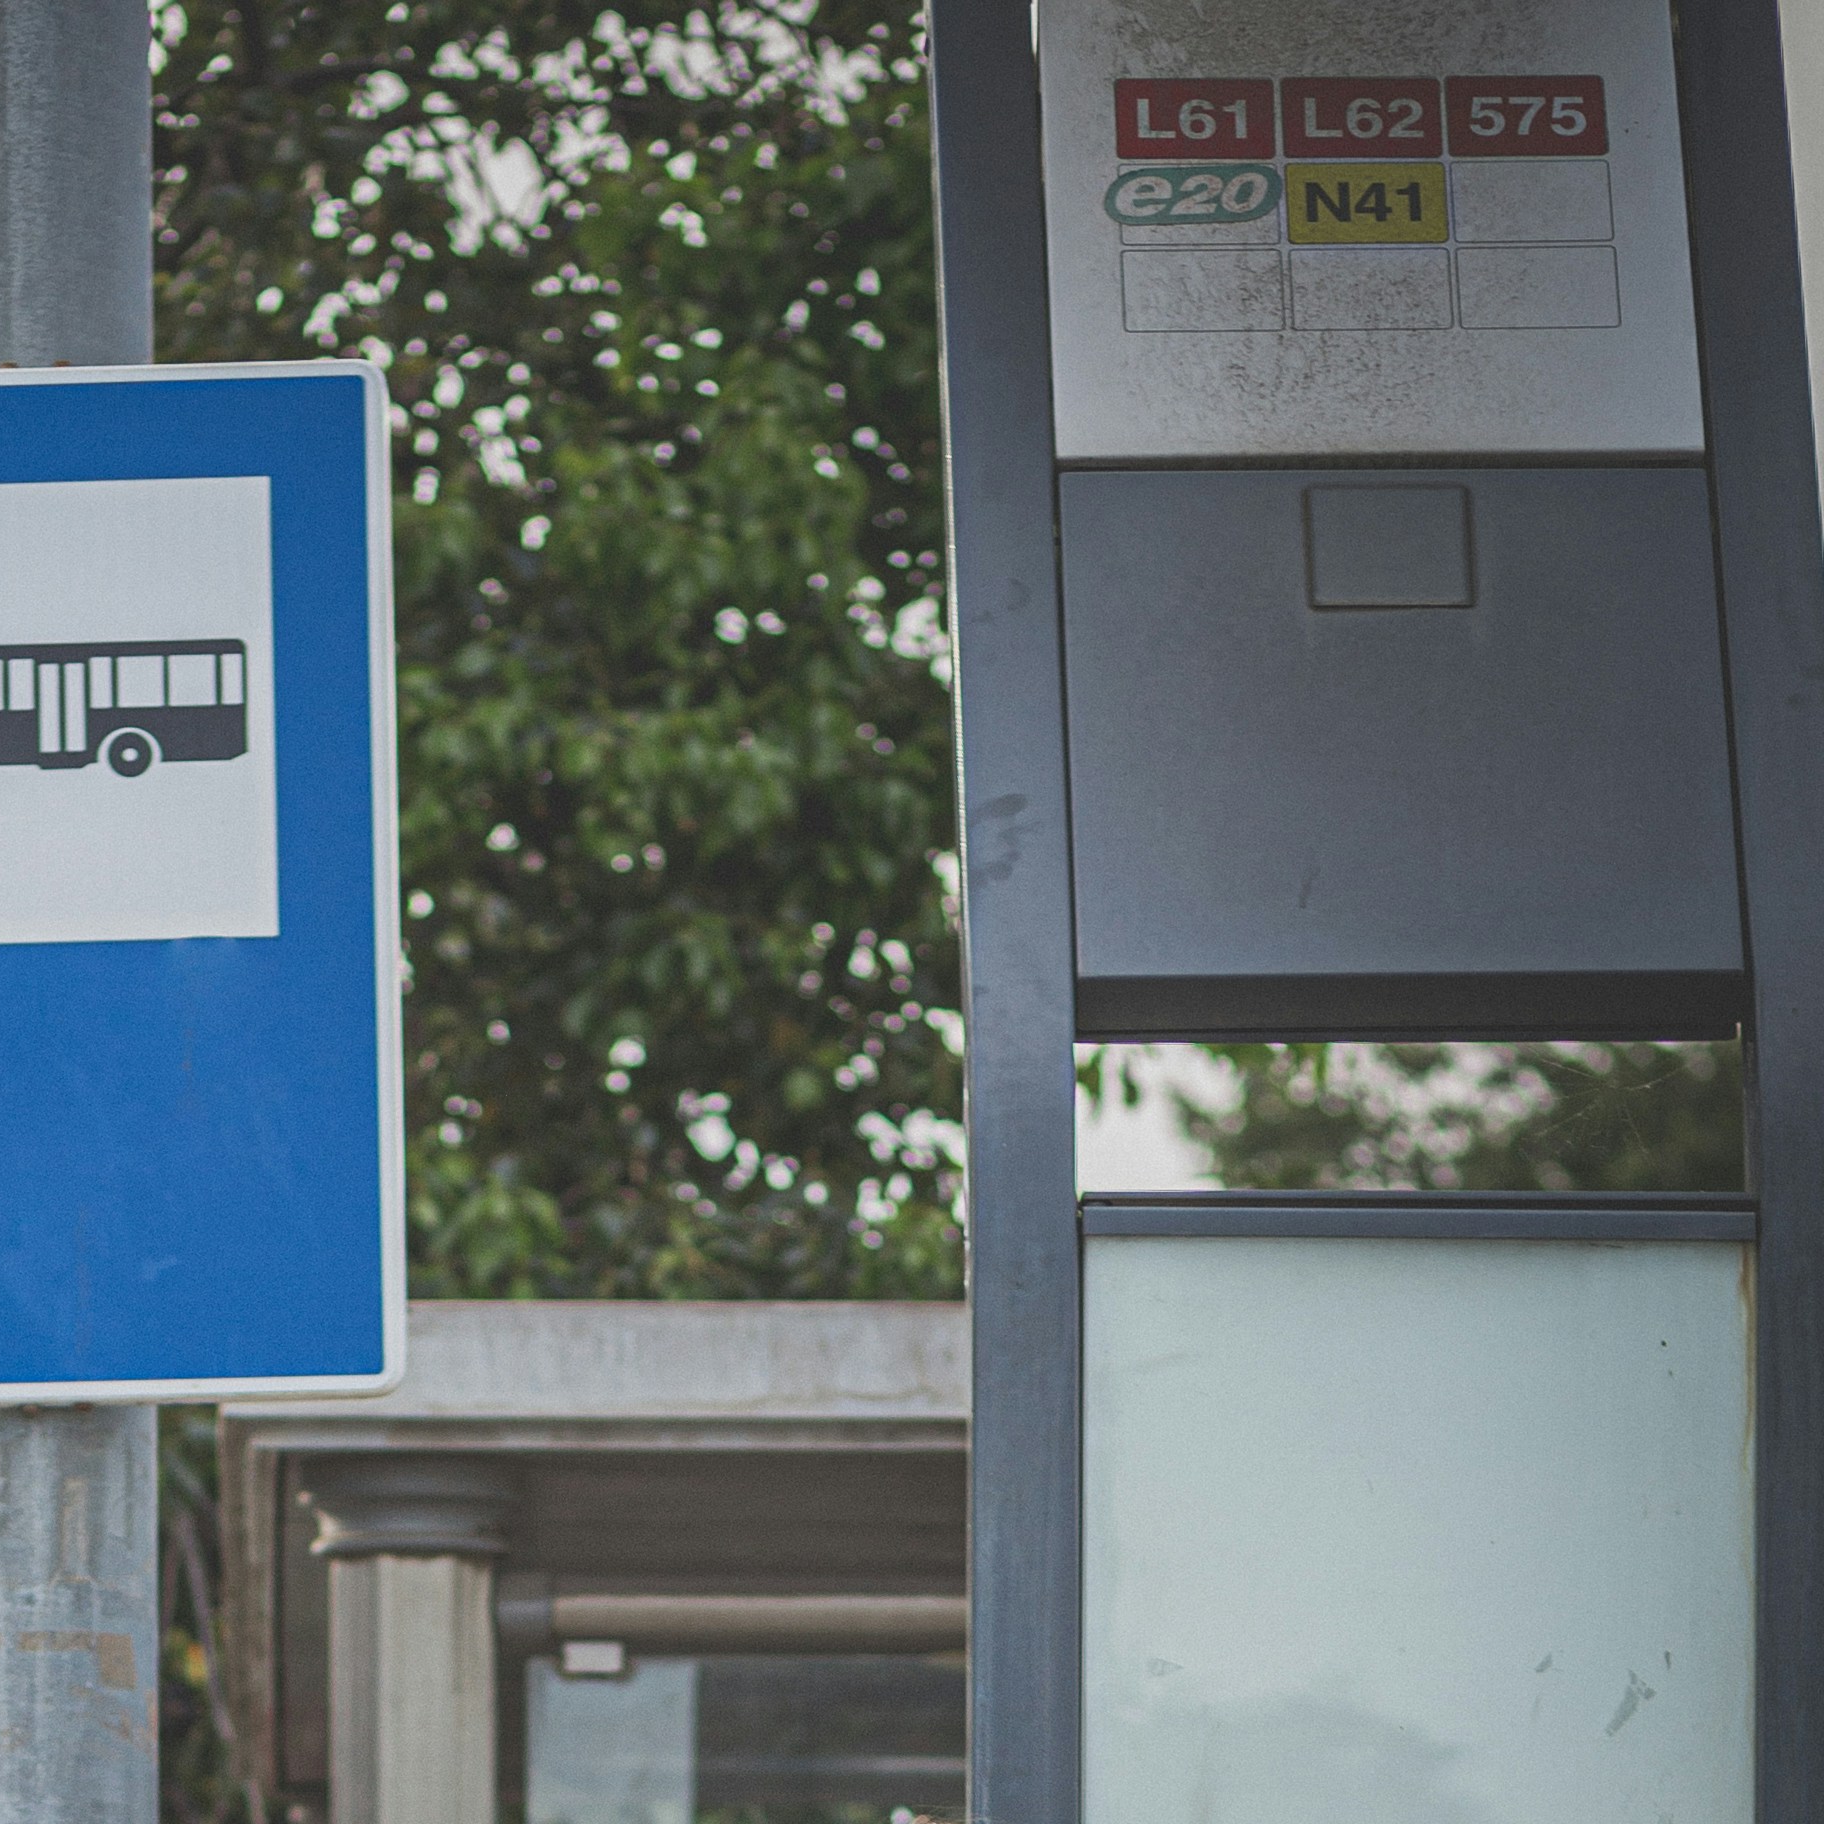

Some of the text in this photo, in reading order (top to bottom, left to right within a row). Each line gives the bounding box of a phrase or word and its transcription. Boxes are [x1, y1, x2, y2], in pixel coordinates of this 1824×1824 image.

[1136, 95, 1588, 140] L61 L62 575
[1114, 171, 1423, 224] e20 N41
